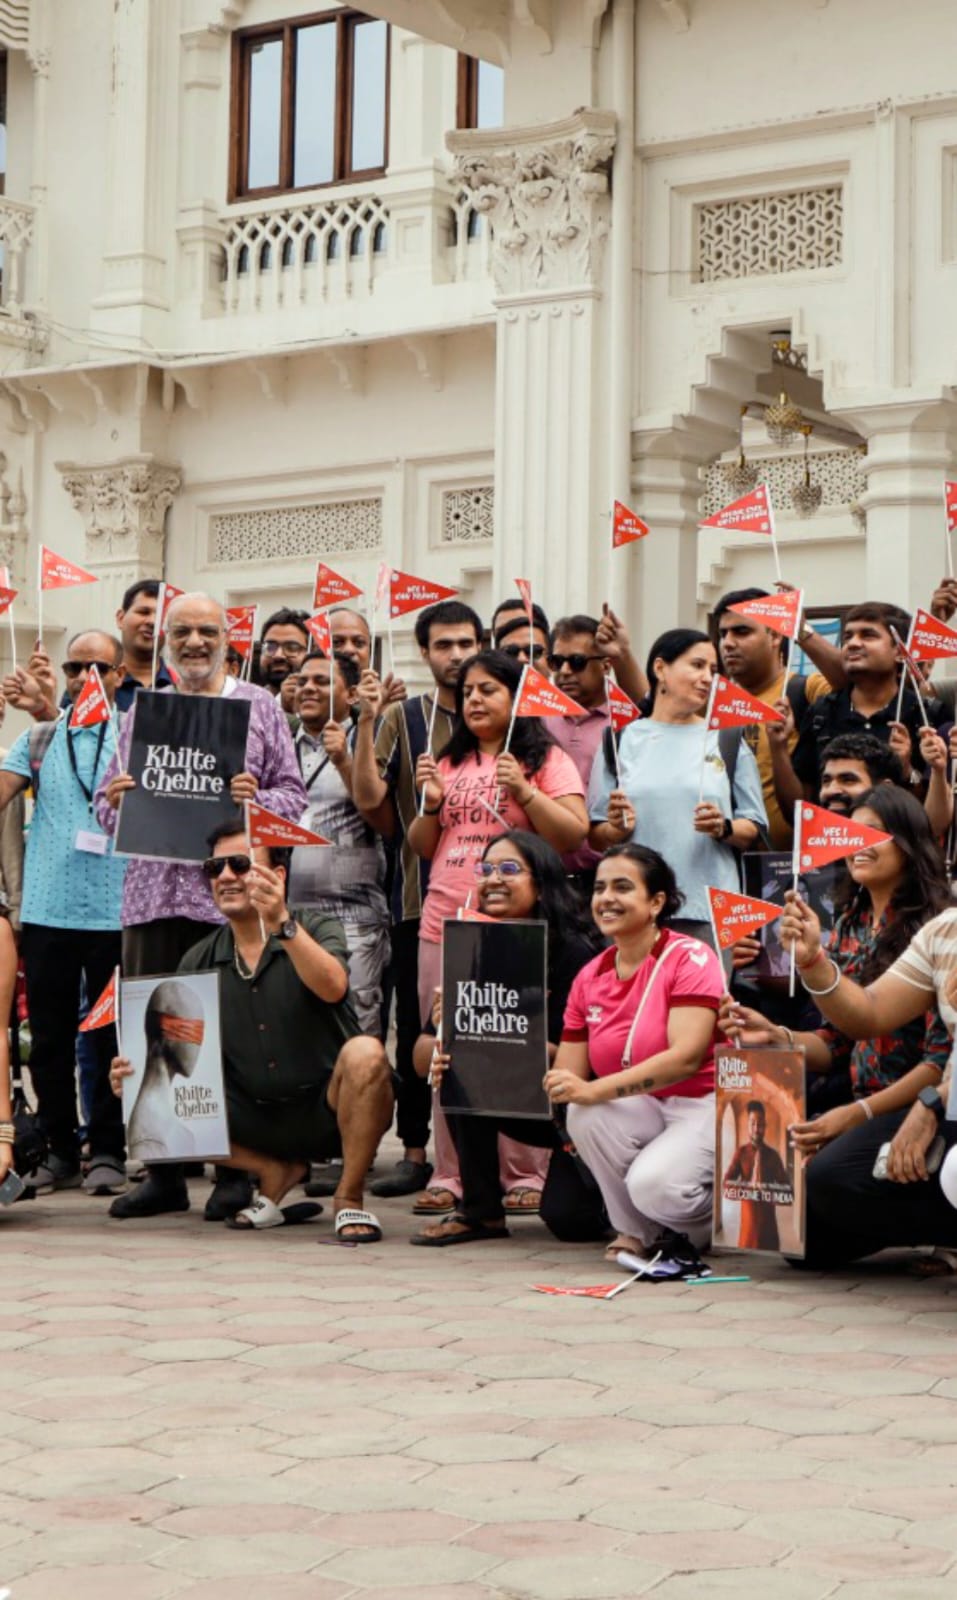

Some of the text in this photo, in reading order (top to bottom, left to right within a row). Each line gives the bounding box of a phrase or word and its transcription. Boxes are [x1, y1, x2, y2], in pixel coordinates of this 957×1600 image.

[144, 744, 217, 771] Khilte
[141, 767, 224, 794] Chehre
[823, 826, 841, 837] YES
[807, 836, 864, 847] CAN TRAVEL
[446, 857, 466, 868] THE
[456, 980, 519, 1009] Khilte
[454, 1006, 529, 1034] Chehre
[718, 1056, 748, 1073] Khilte
[174, 1084, 212, 1104] Khilte
[174, 1101, 219, 1118] Chehre
